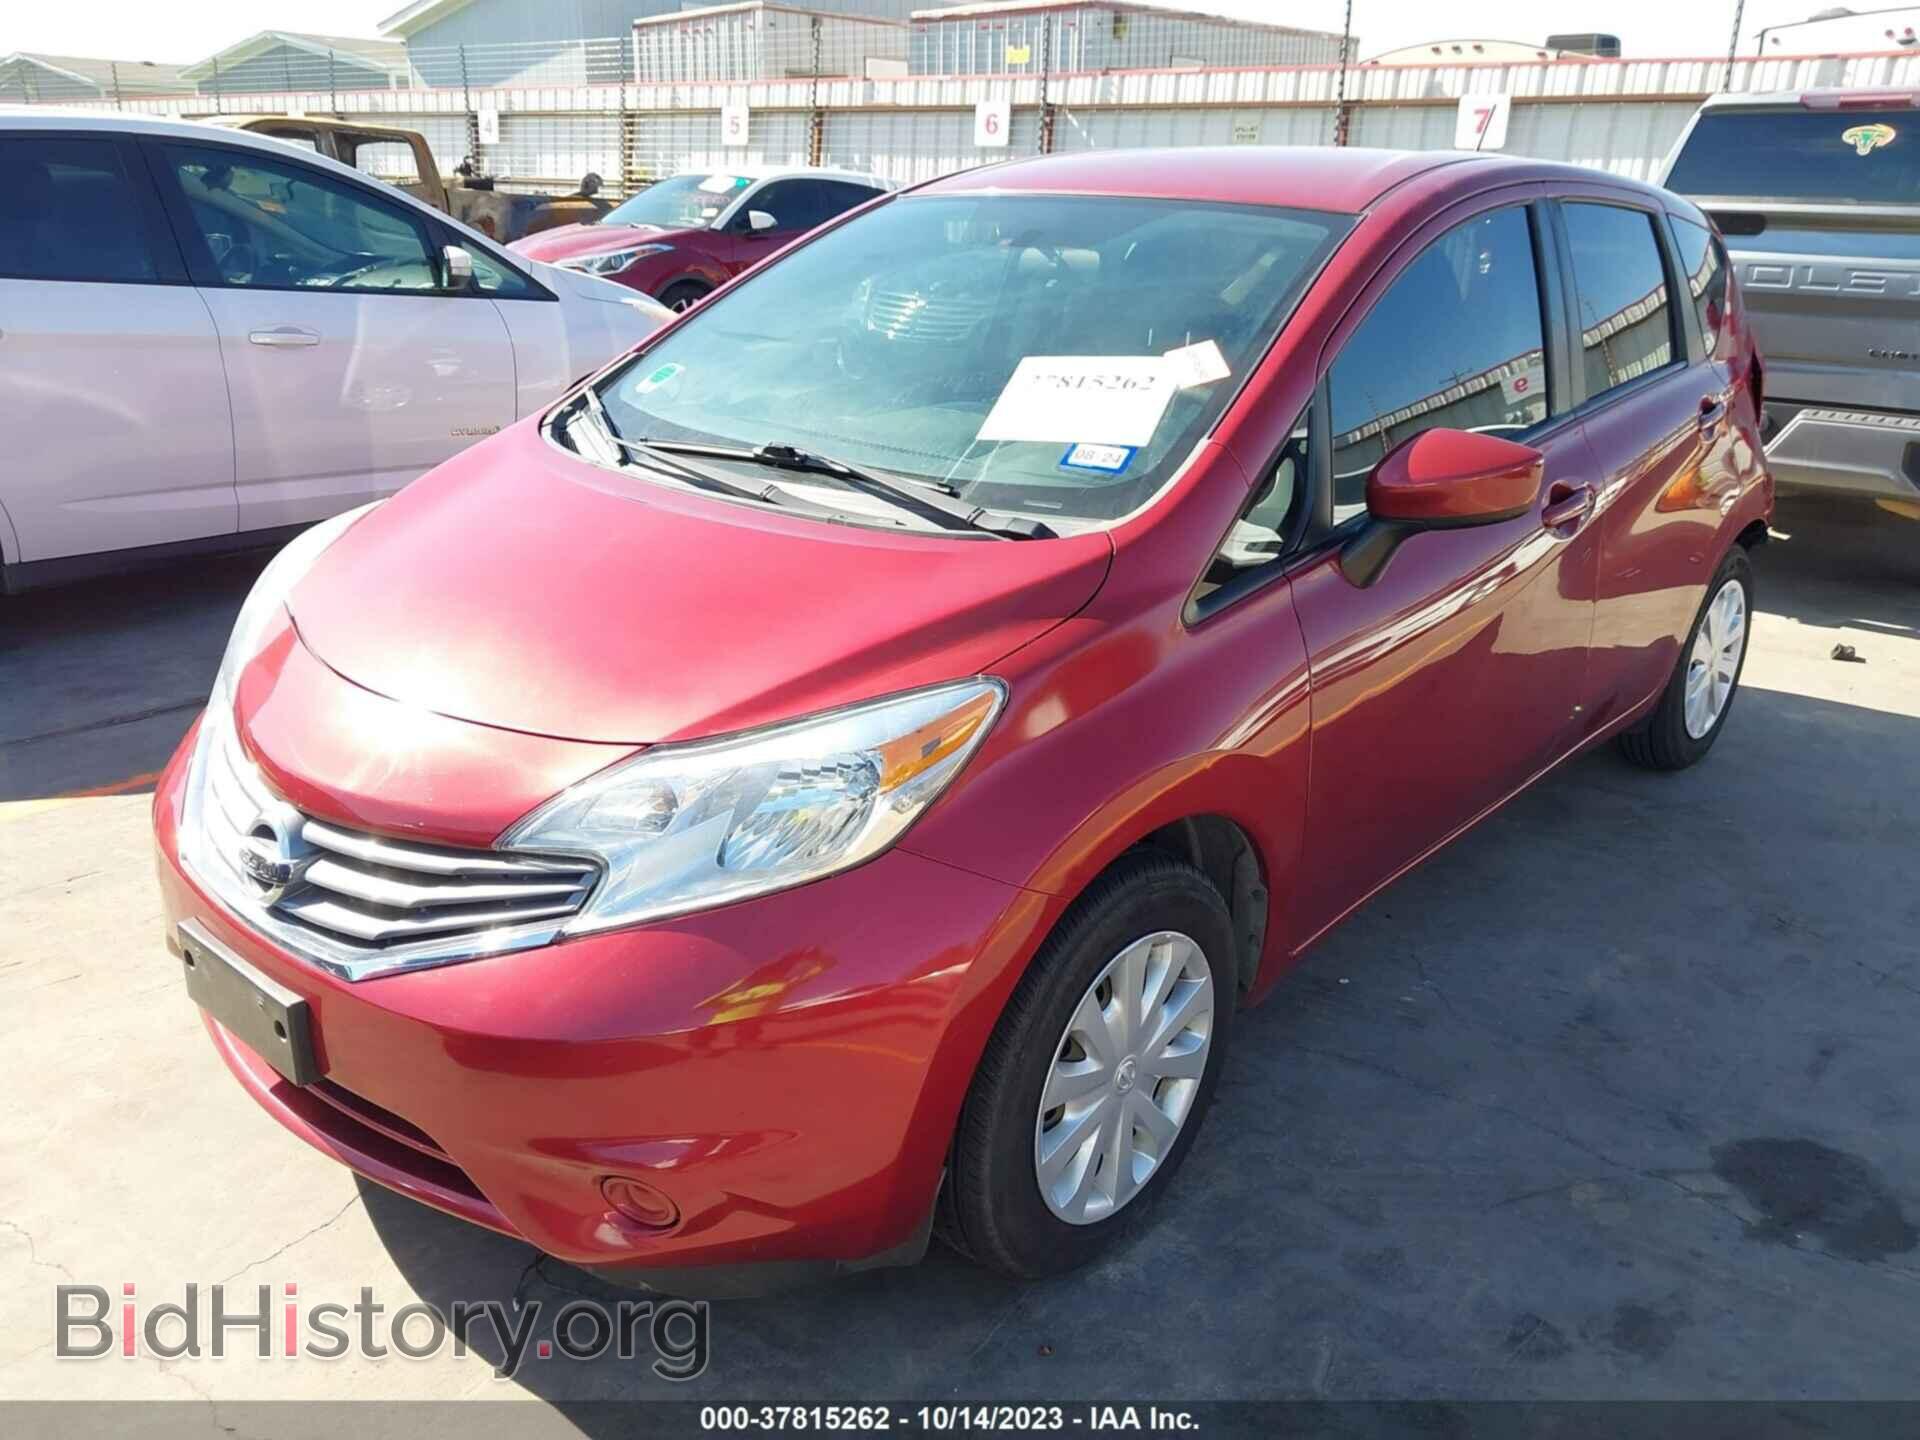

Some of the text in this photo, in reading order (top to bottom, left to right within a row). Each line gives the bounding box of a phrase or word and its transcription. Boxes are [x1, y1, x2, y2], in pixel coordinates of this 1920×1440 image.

[729, 115, 741, 136] 5
[985, 113, 999, 135] 6
[1473, 108, 1490, 134] 7
[1032, 374, 1157, 391] 7815262
